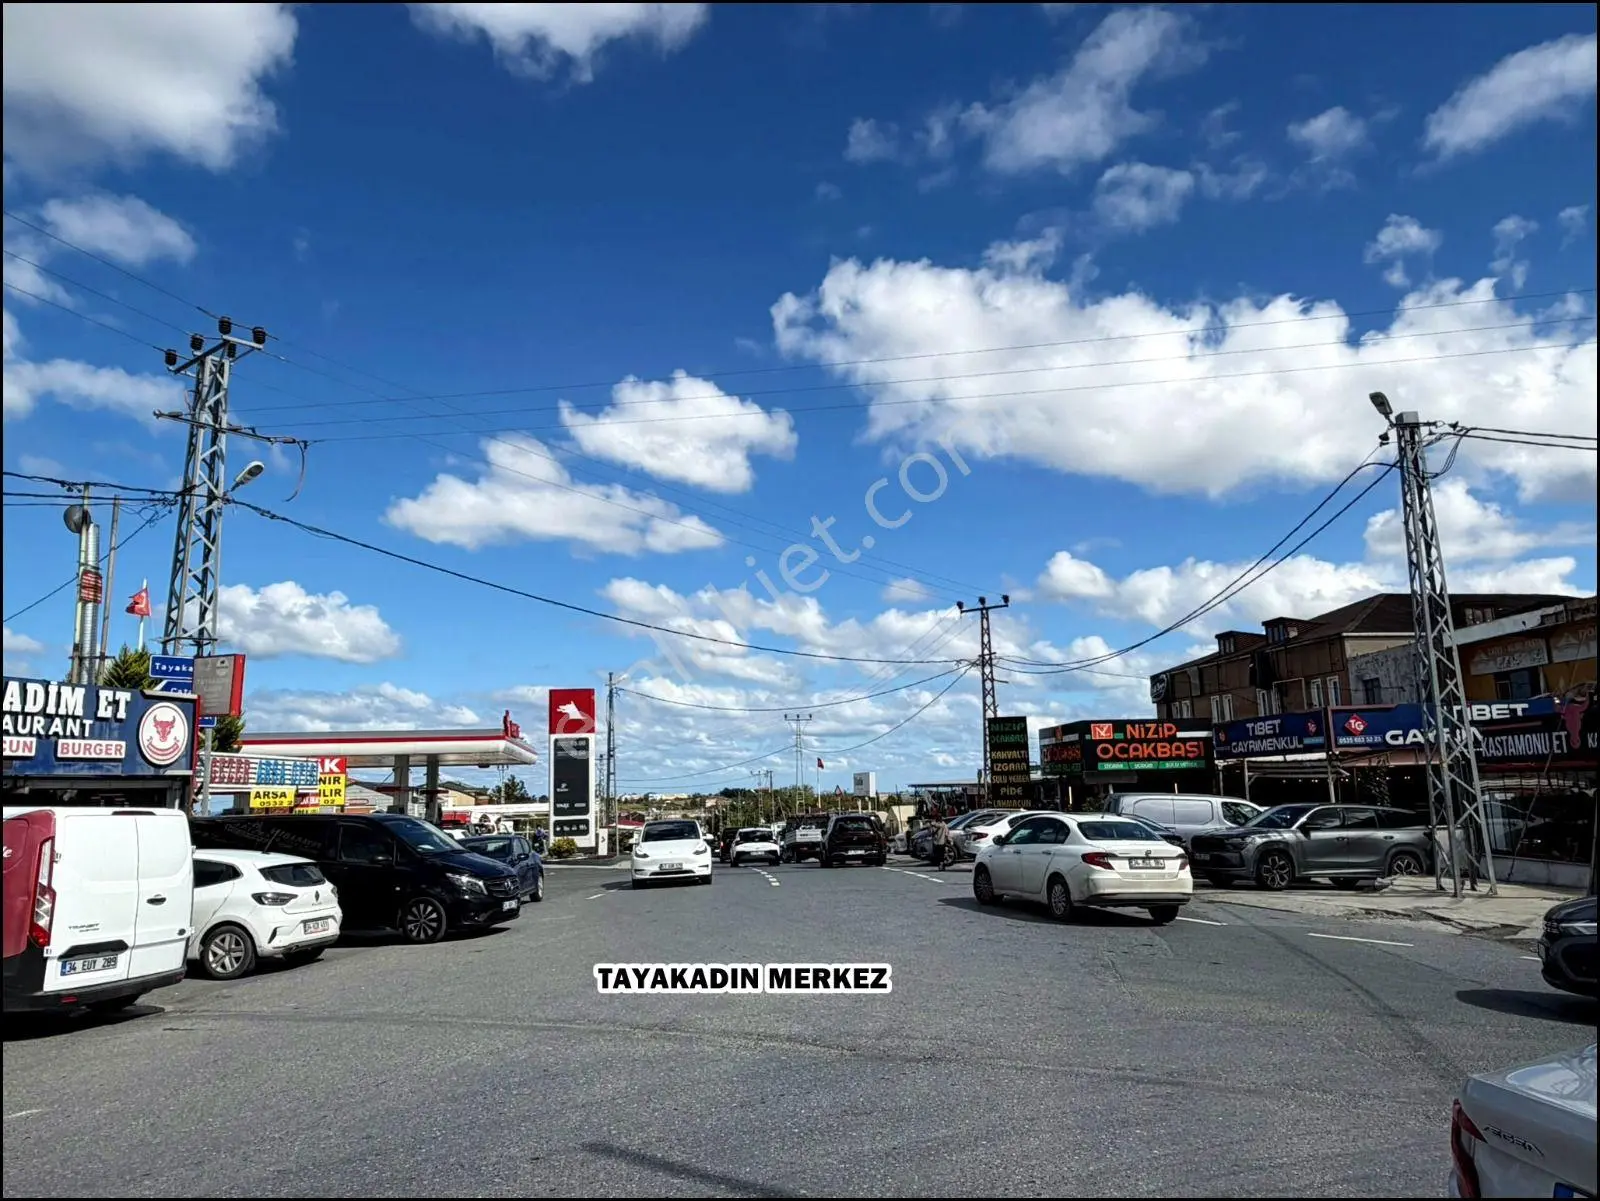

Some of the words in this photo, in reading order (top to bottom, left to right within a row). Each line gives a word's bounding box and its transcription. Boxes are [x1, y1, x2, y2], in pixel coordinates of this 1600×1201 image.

[97, 690, 131, 719] ET
[60, 743, 124, 757] BURGER
[1482, 734, 1550, 758] KASTAMONU
[1552, 731, 1568, 754] ET
[253, 790, 288, 801] ARSA
[67, 961, 77, 973] 34
[82, 959, 97, 971] EUY
